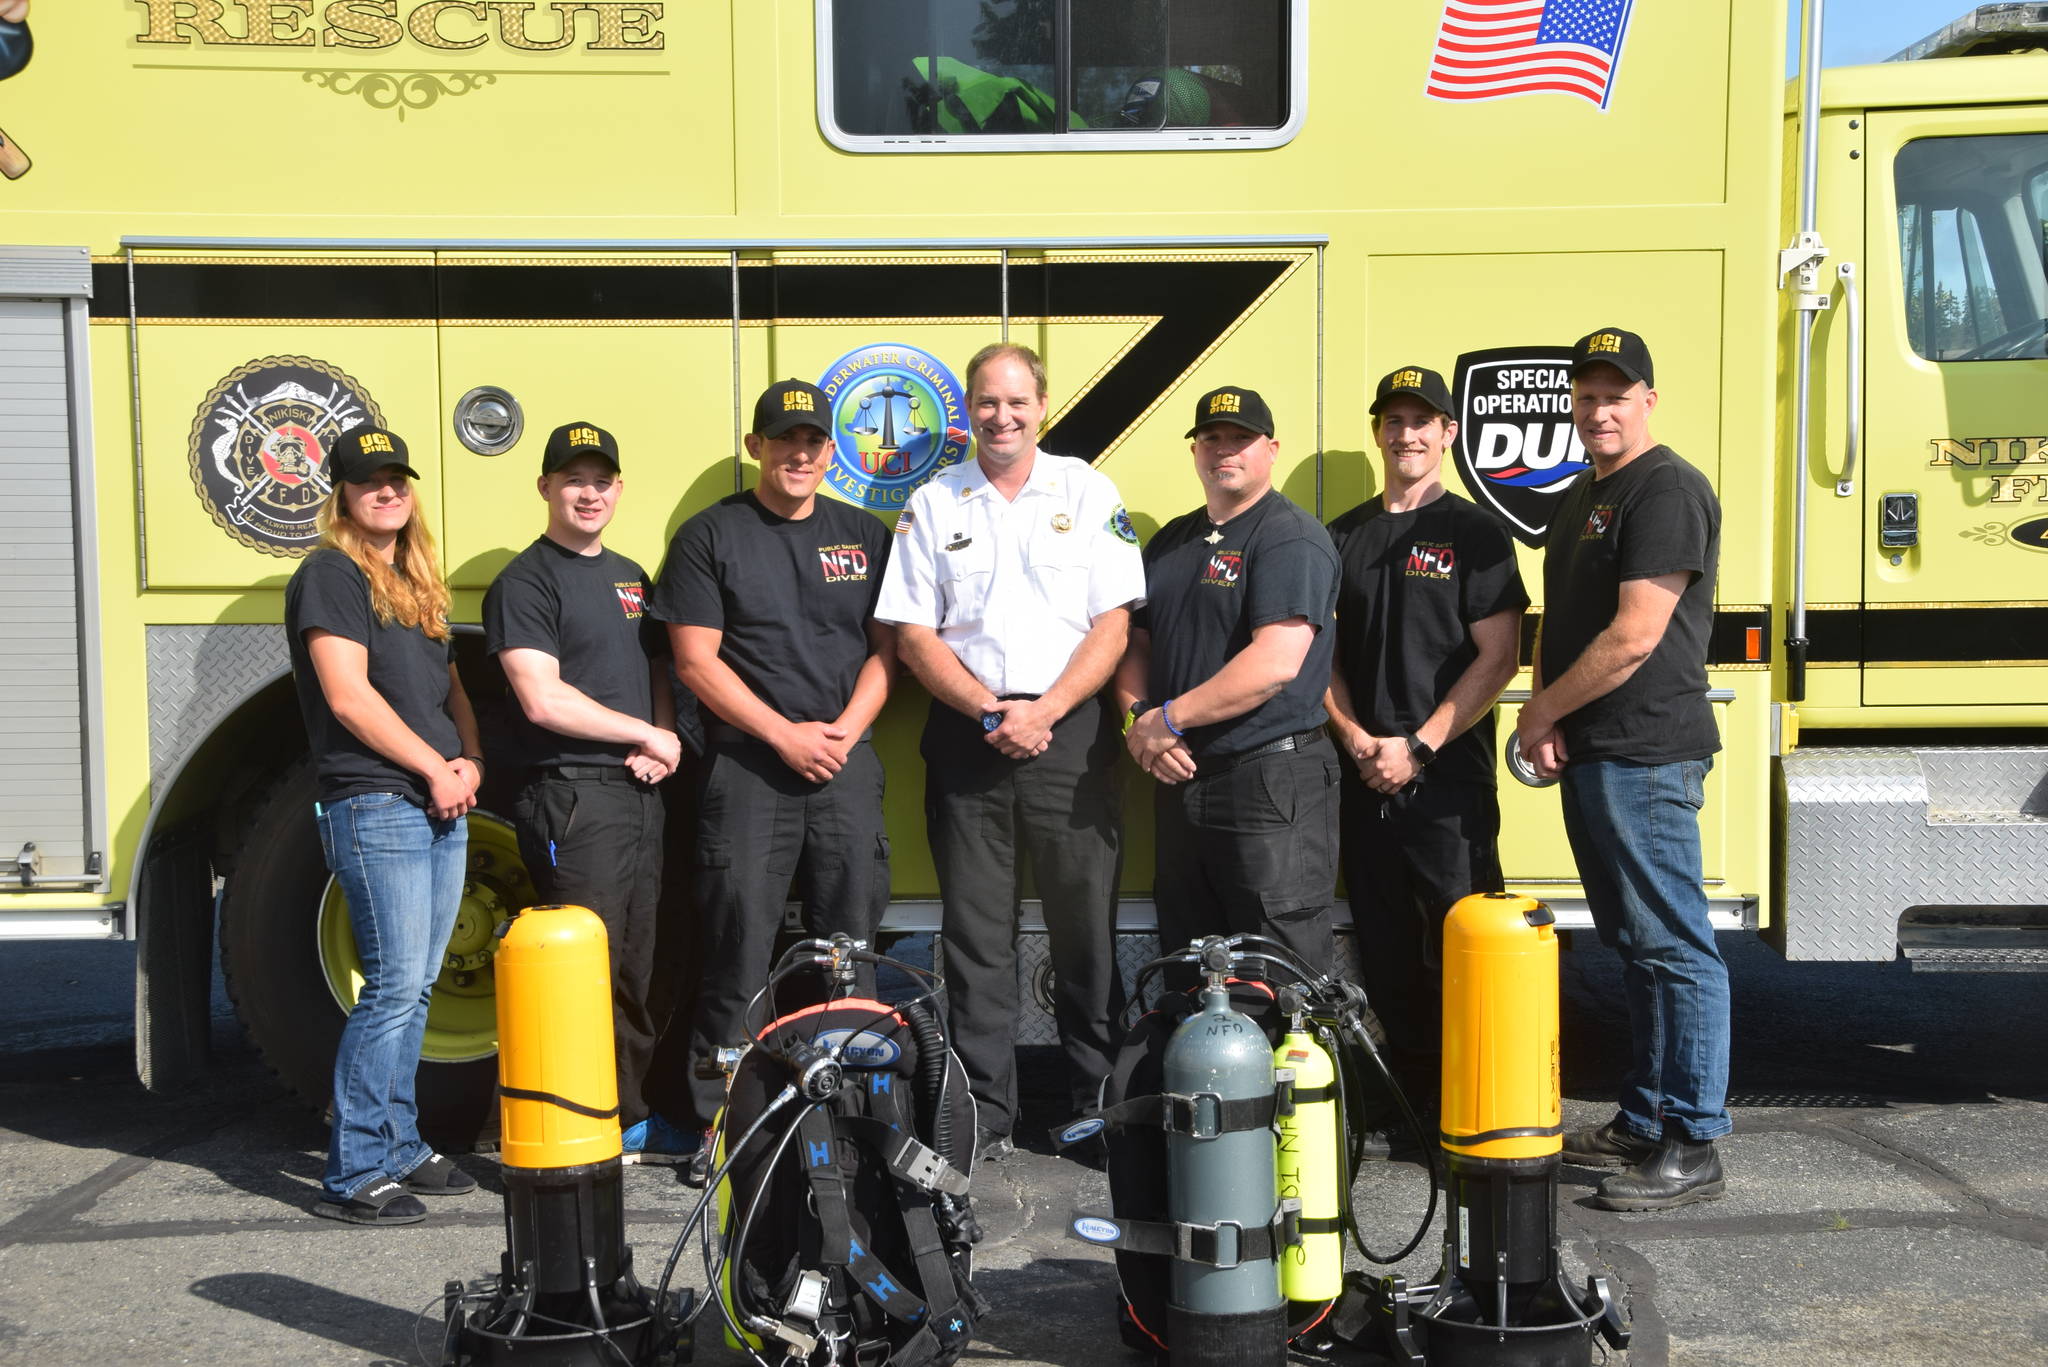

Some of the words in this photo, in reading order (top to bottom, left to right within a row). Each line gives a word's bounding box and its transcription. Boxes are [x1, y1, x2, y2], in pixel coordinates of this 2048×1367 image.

[134, 0, 665, 51] RESCUE
[1590, 333, 1622, 347] UCI
[1588, 345, 1620, 354] DIVER
[824, 352, 902, 402] DERWATER
[1393, 370, 1422, 384] UCI
[1496, 368, 1573, 390] SPECIA
[905, 354, 961, 424] CRIMINAL
[1391, 380, 1422, 390] DIVER
[783, 390, 814, 405] UCI
[1210, 393, 1241, 408] UCI
[1473, 393, 1572, 416] OPERATIO
[783, 403, 815, 412] DIVER
[1209, 405, 1240, 415] DIVER
[359, 432, 391, 447] UCI
[569, 427, 600, 442] UCI
[362, 444, 394, 455] DIVER
[570, 438, 601, 447] DIVER
[244, 434, 256, 476] DIVE
[858, 451, 913, 475] UCI
[254, 522, 287, 537] PROUD
[263, 518, 295, 530] ALWAYS
[297, 520, 317, 530] REA
[819, 550, 868, 577] NFD
[1407, 546, 1455, 573] NFD
[1204, 555, 1243, 582] NFD
[1405, 570, 1451, 580] DIVER
[825, 574, 868, 583] DIVER
[1206, 1023, 1243, 1037] NFD
